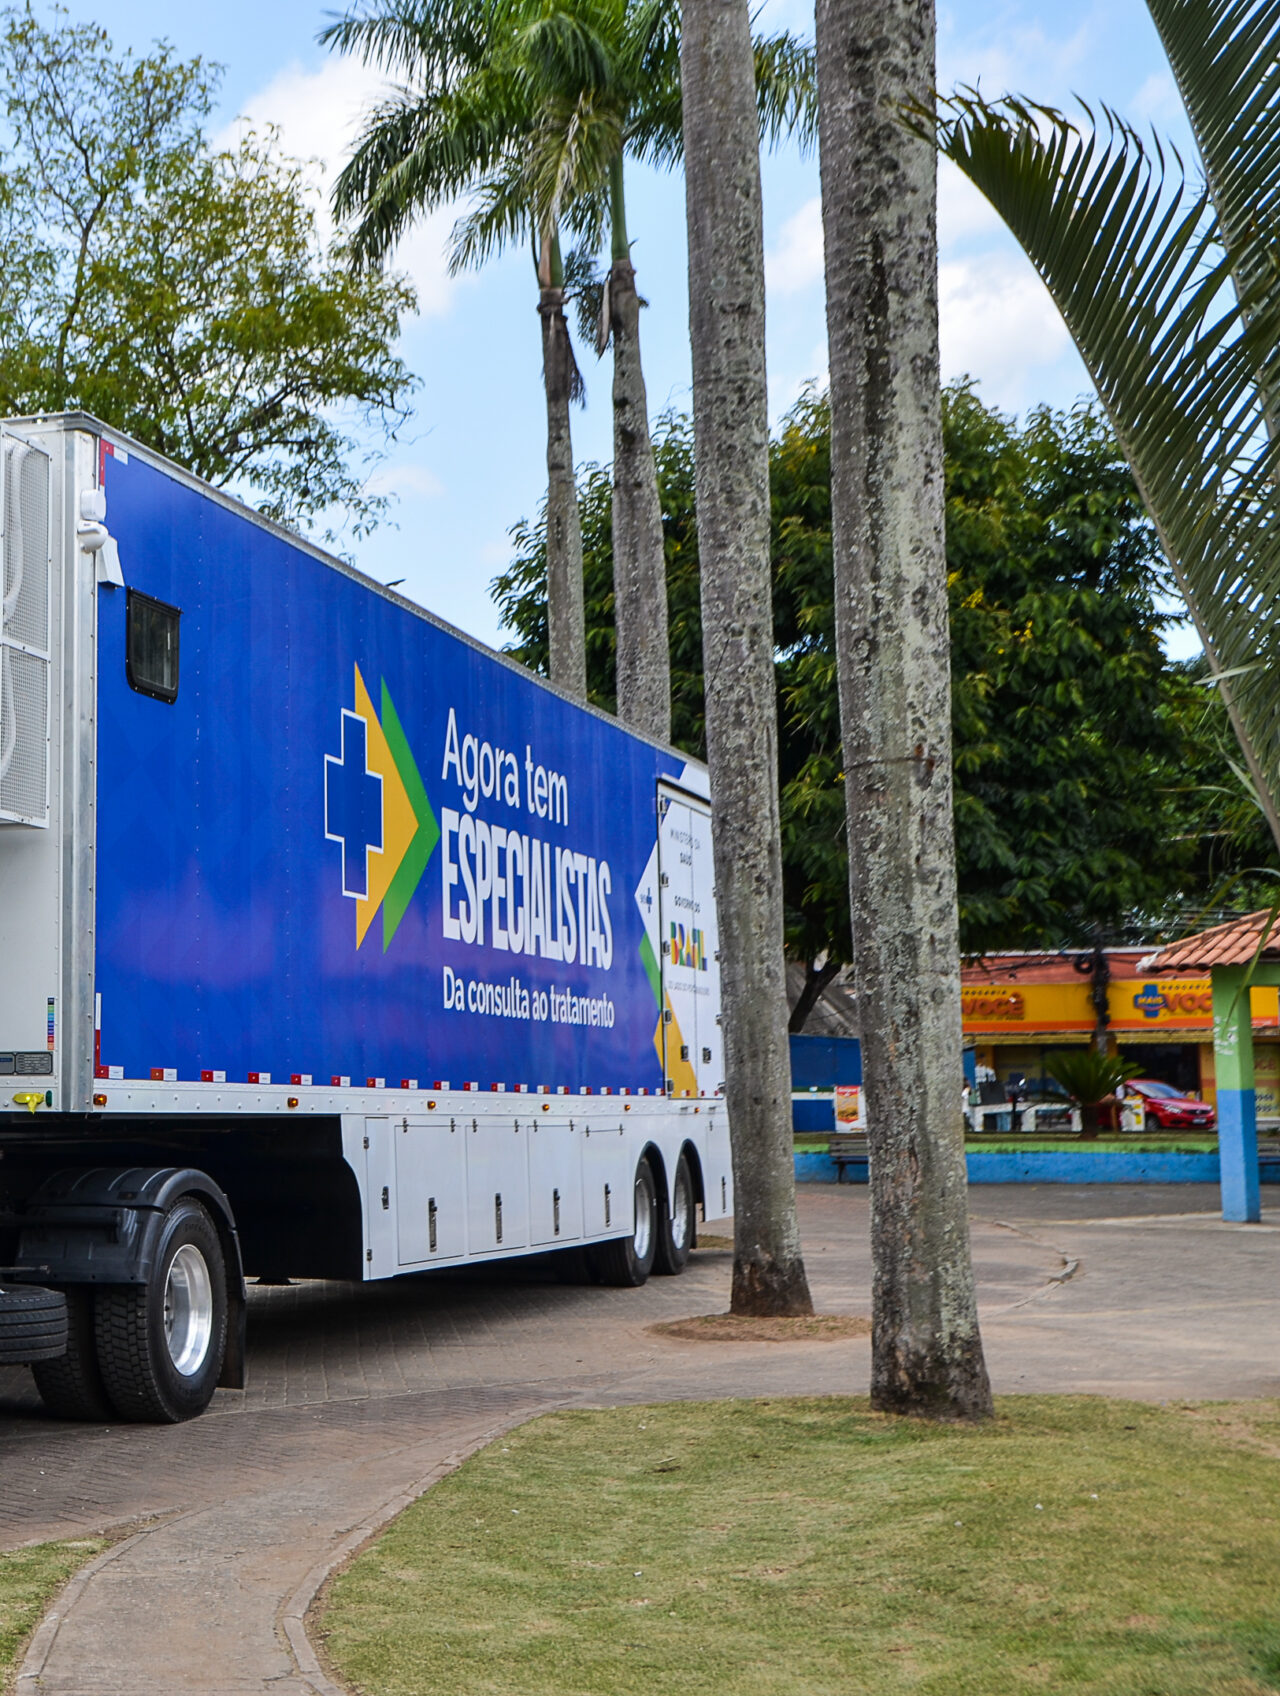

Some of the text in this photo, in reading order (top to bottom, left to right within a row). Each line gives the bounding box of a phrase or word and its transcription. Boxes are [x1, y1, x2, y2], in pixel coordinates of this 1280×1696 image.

[441, 706, 569, 827] Agora tem
[441, 806, 614, 971] ESPECIALISTAS
[442, 965, 615, 1029] Da consulta ao tratamento
[1164, 992, 1212, 1012] VOC
